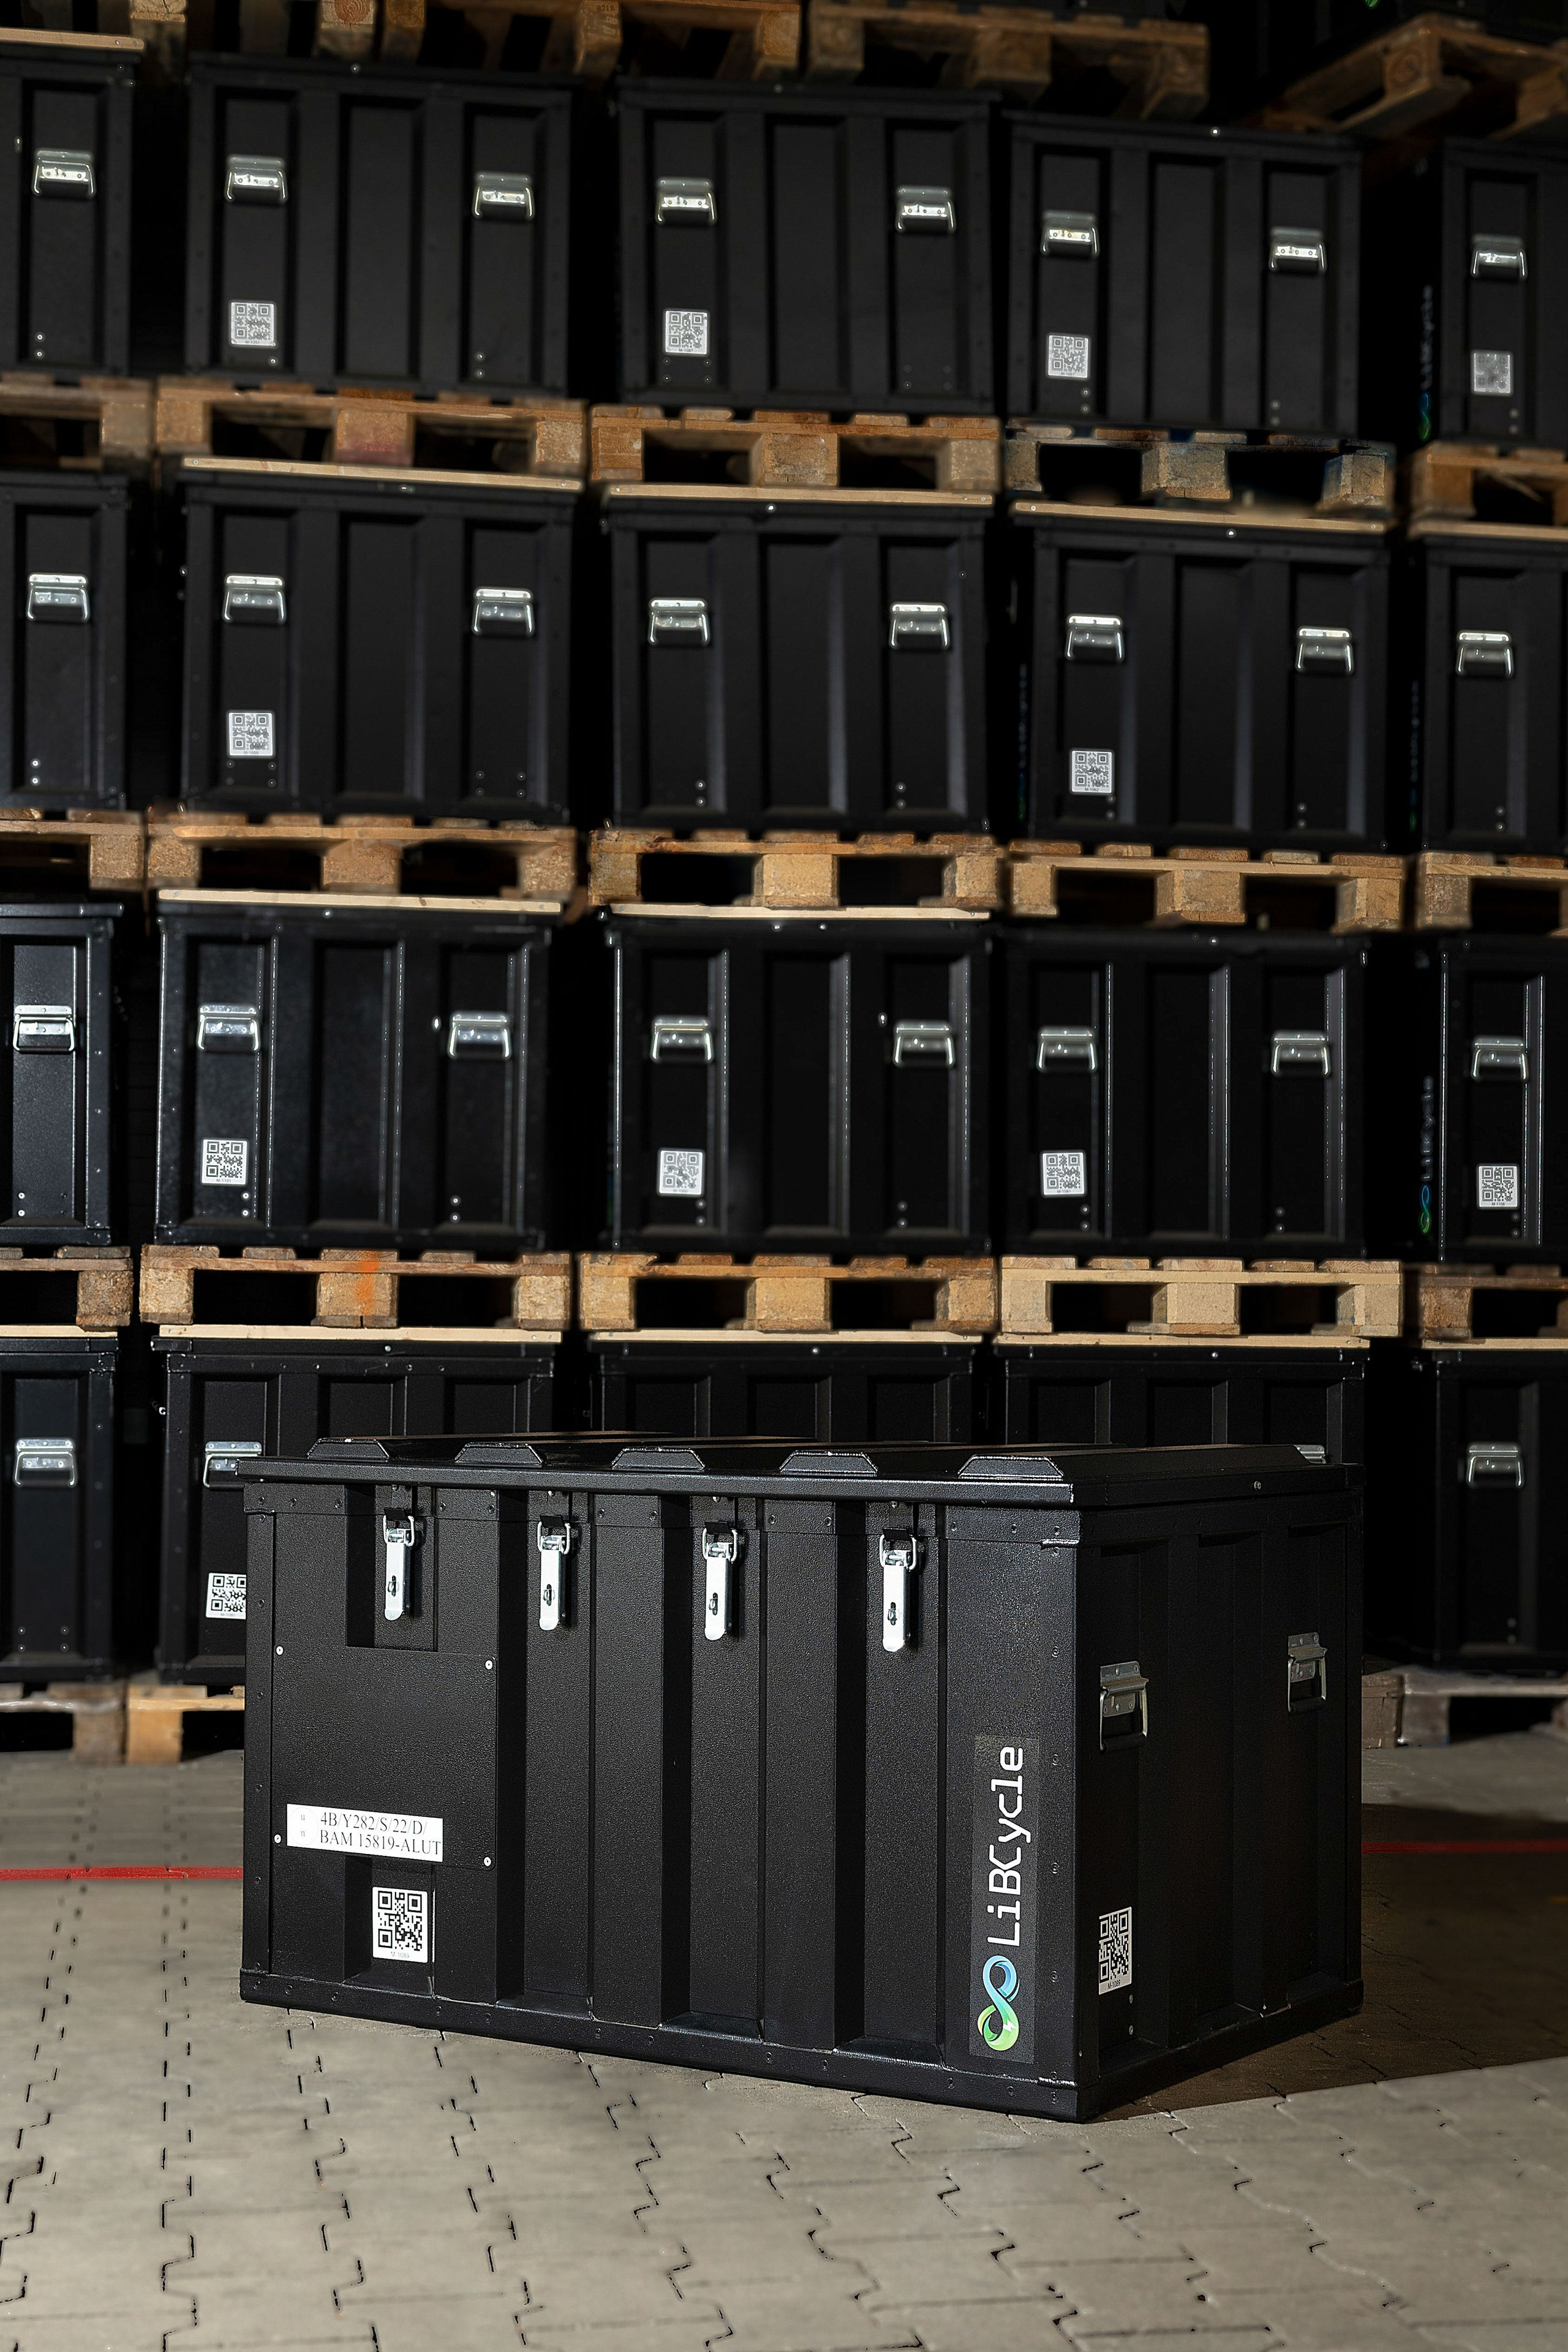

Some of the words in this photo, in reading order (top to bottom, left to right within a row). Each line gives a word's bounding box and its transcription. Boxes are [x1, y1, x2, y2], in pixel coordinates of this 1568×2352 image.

[320, 1811, 428, 1836] 4B/Y282/S/22/D/
[320, 1829, 353, 1846] BAM
[359, 1833, 441, 1855] 15819-ALUT
[987, 1746, 1031, 1947] LiBCycle
